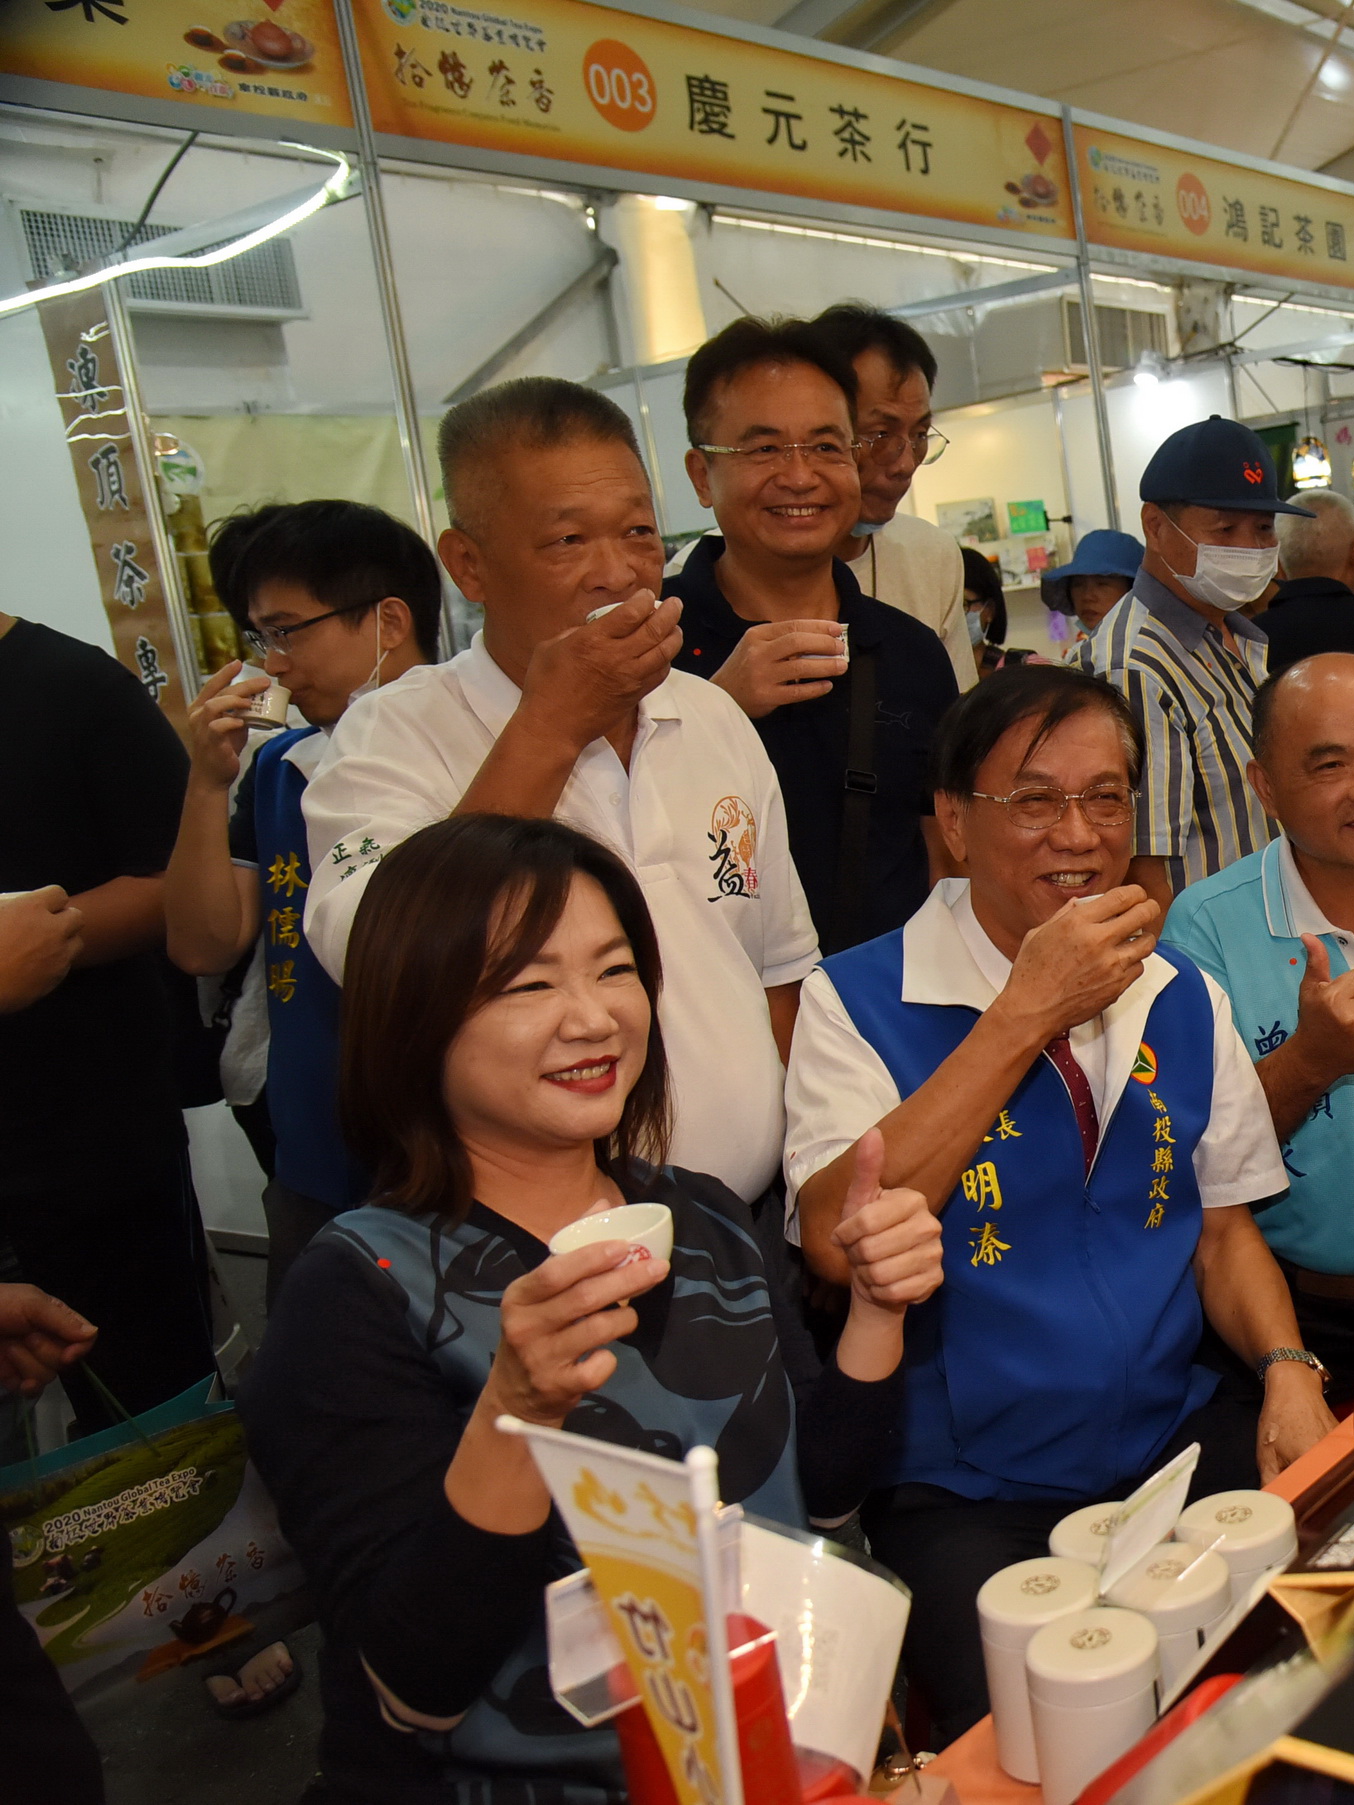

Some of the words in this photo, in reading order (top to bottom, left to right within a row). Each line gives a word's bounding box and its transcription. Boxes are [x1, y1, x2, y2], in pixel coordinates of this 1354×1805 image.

[589, 64, 653, 113] 003
[685, 74, 933, 175] 慶元茶行
[1178, 191, 1209, 222] 004
[1222, 195, 1347, 262] 鴻記茶園
[1144, 1088, 1178, 1230] 南投縣政府
[44, 1511, 81, 1534] 2020
[83, 1496, 120, 1518] Nantou
[121, 1483, 151, 1502] Global
[151, 1477, 171, 1491] Tea
[172, 1467, 196, 1484] Expo
